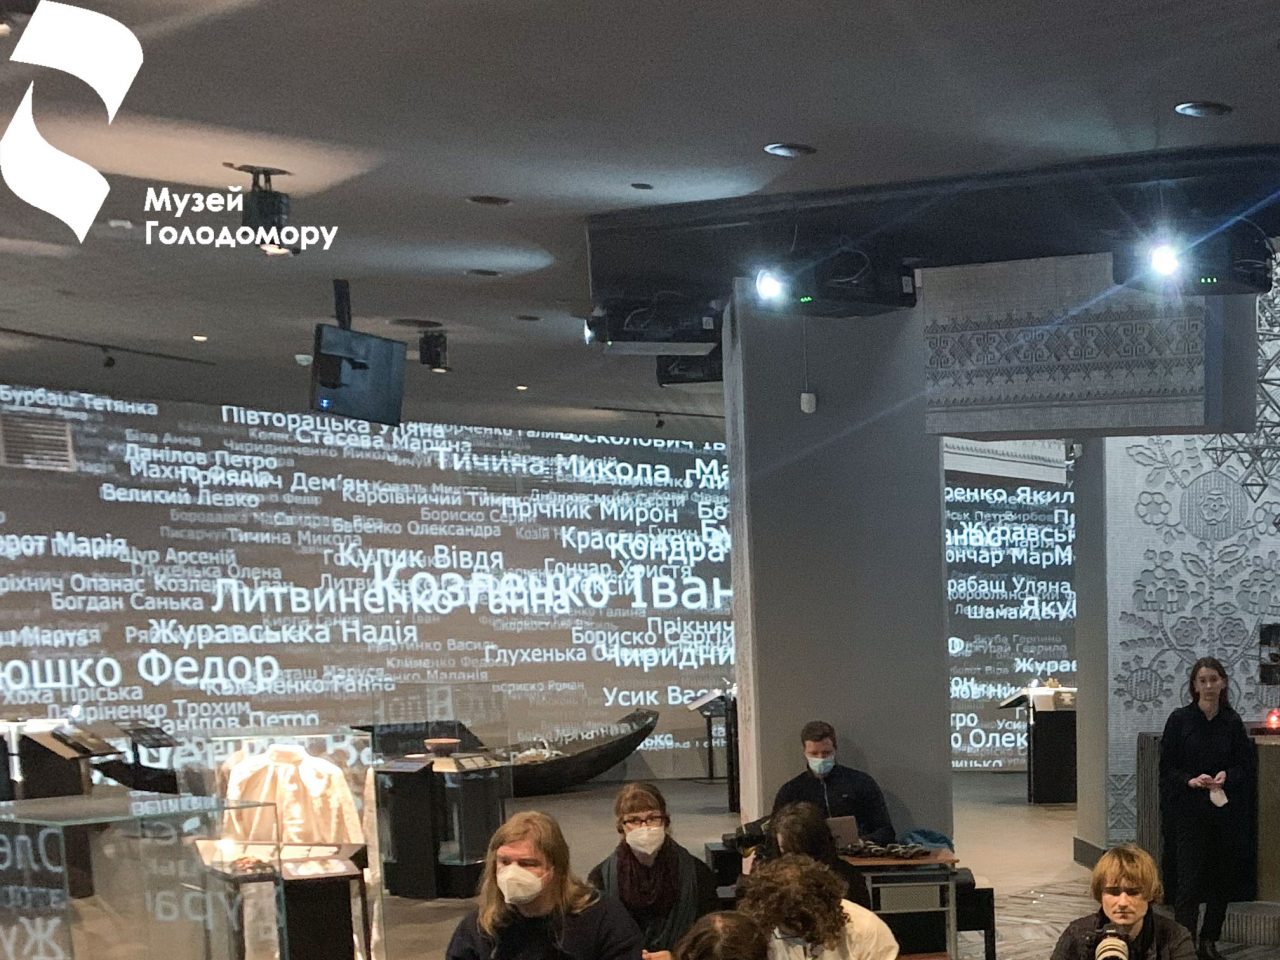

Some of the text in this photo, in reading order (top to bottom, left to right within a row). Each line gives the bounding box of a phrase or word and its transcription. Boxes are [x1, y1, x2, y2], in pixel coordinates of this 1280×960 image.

[221, 404, 370, 434] Півторацька
[296, 426, 384, 449] Стасева
[393, 435, 472, 453] Марина
[125, 443, 278, 470] Данілов Петро
[557, 453, 671, 480] Микола
[100, 483, 192, 504] Великий
[197, 488, 260, 508] Левко
[600, 501, 678, 526] Мирон
[407, 520, 501, 538] Олександра
[165, 547, 236, 567] Арсеній
[434, 544, 504, 569] Вівдя
[228, 563, 282, 579] Олена
[70, 574, 145, 593] Опанас
[1012, 576, 1071, 592] Уляна
[51, 593, 204, 613] Богдан Санька
[342, 619, 418, 647] Надія
[571, 626, 657, 645] Бориско
[484, 647, 587, 668] Глухенька
[137, 648, 280, 692] Федор
[602, 686, 660, 707] Усик
[172, 699, 251, 717] Трохим
